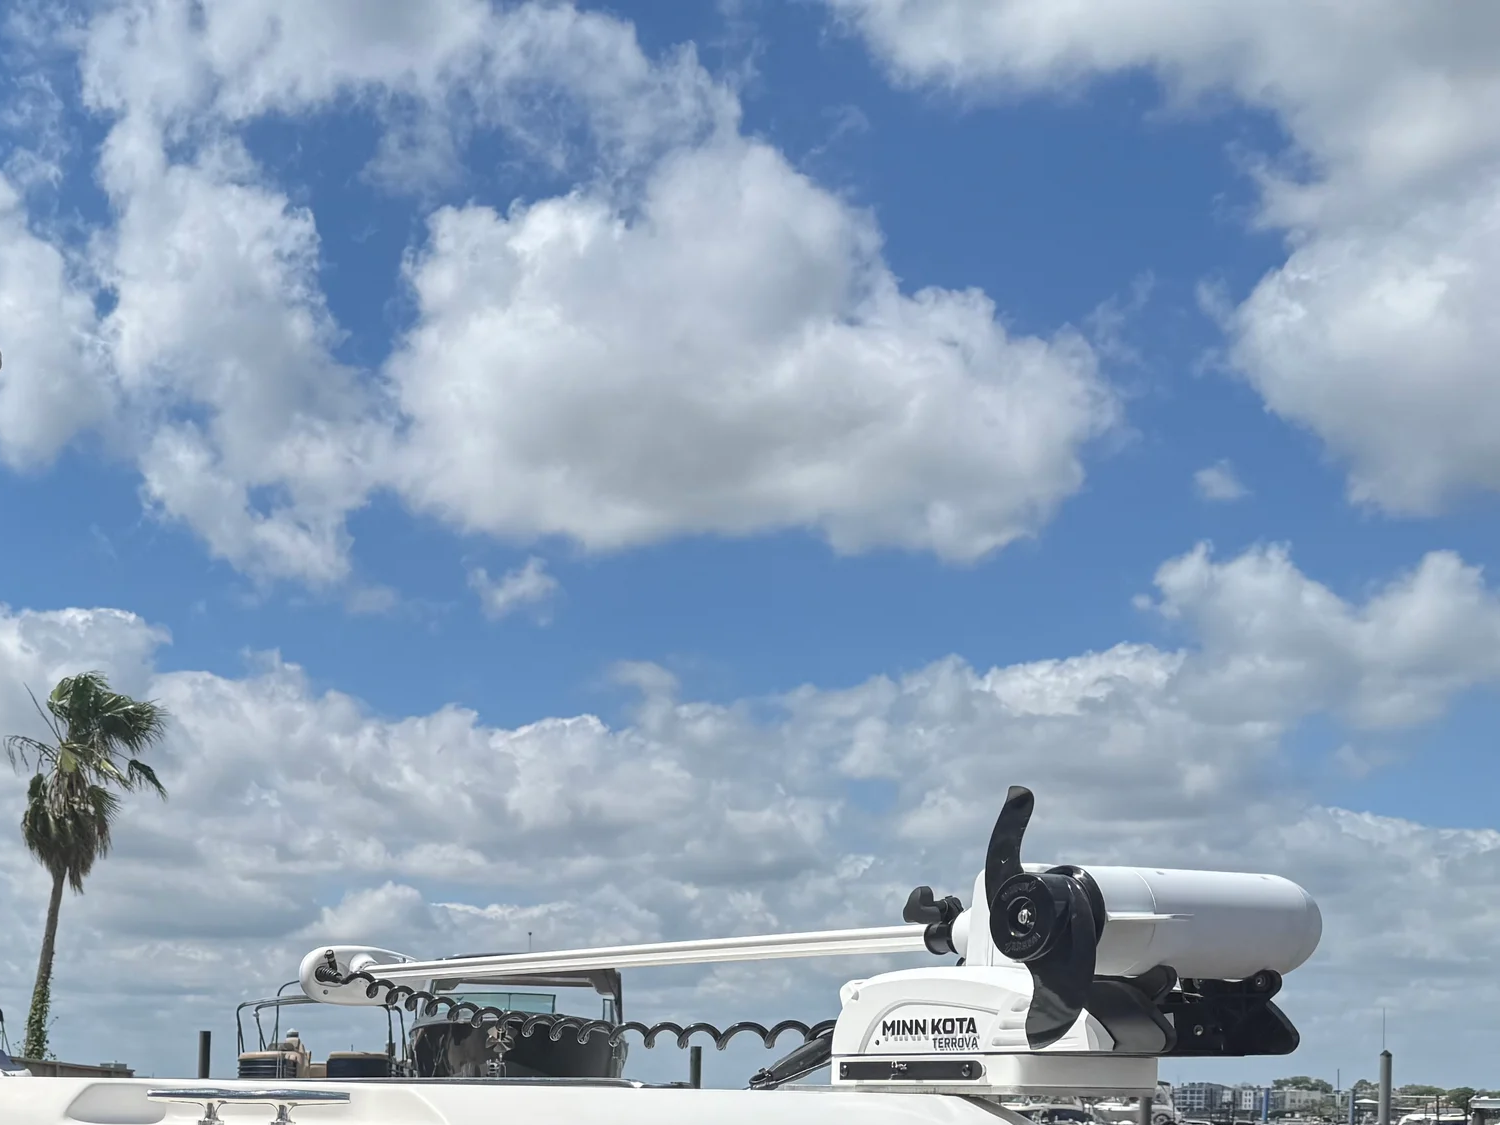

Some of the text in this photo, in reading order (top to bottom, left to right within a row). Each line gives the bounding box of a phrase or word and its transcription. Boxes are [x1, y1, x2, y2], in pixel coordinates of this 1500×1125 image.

[882, 1017, 978, 1036] MINN KOTA
[932, 1037, 978, 1049] TERROVA
